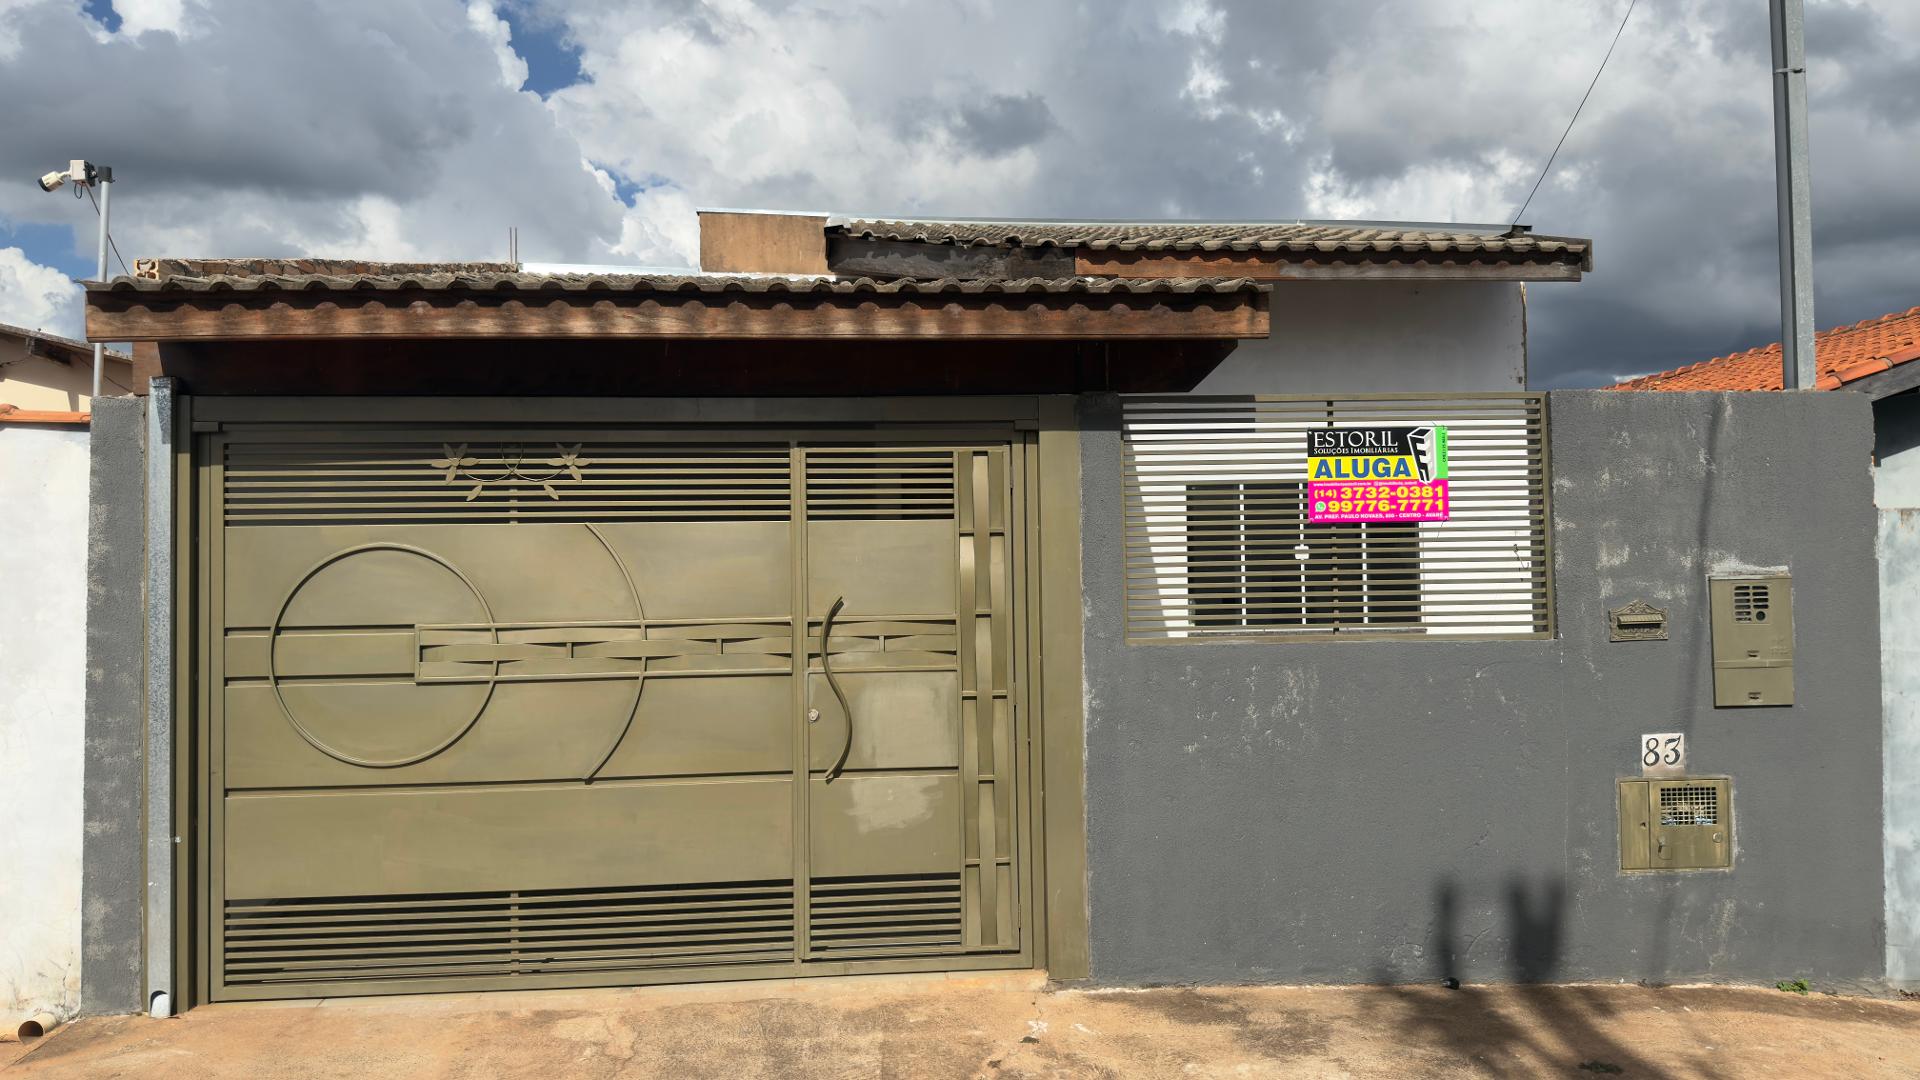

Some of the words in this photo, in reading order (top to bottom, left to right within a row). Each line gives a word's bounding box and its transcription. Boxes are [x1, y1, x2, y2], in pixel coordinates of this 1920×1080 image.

[1314, 431, 1398, 448] ESTORIL
[1314, 457, 1411, 478] ALUGA
[1314, 489, 1337, 499] (14)
[1340, 485, 1443, 499] 3732-0381
[1328, 499, 1443, 513] 99776-7771
[1643, 735, 1682, 767] 83
